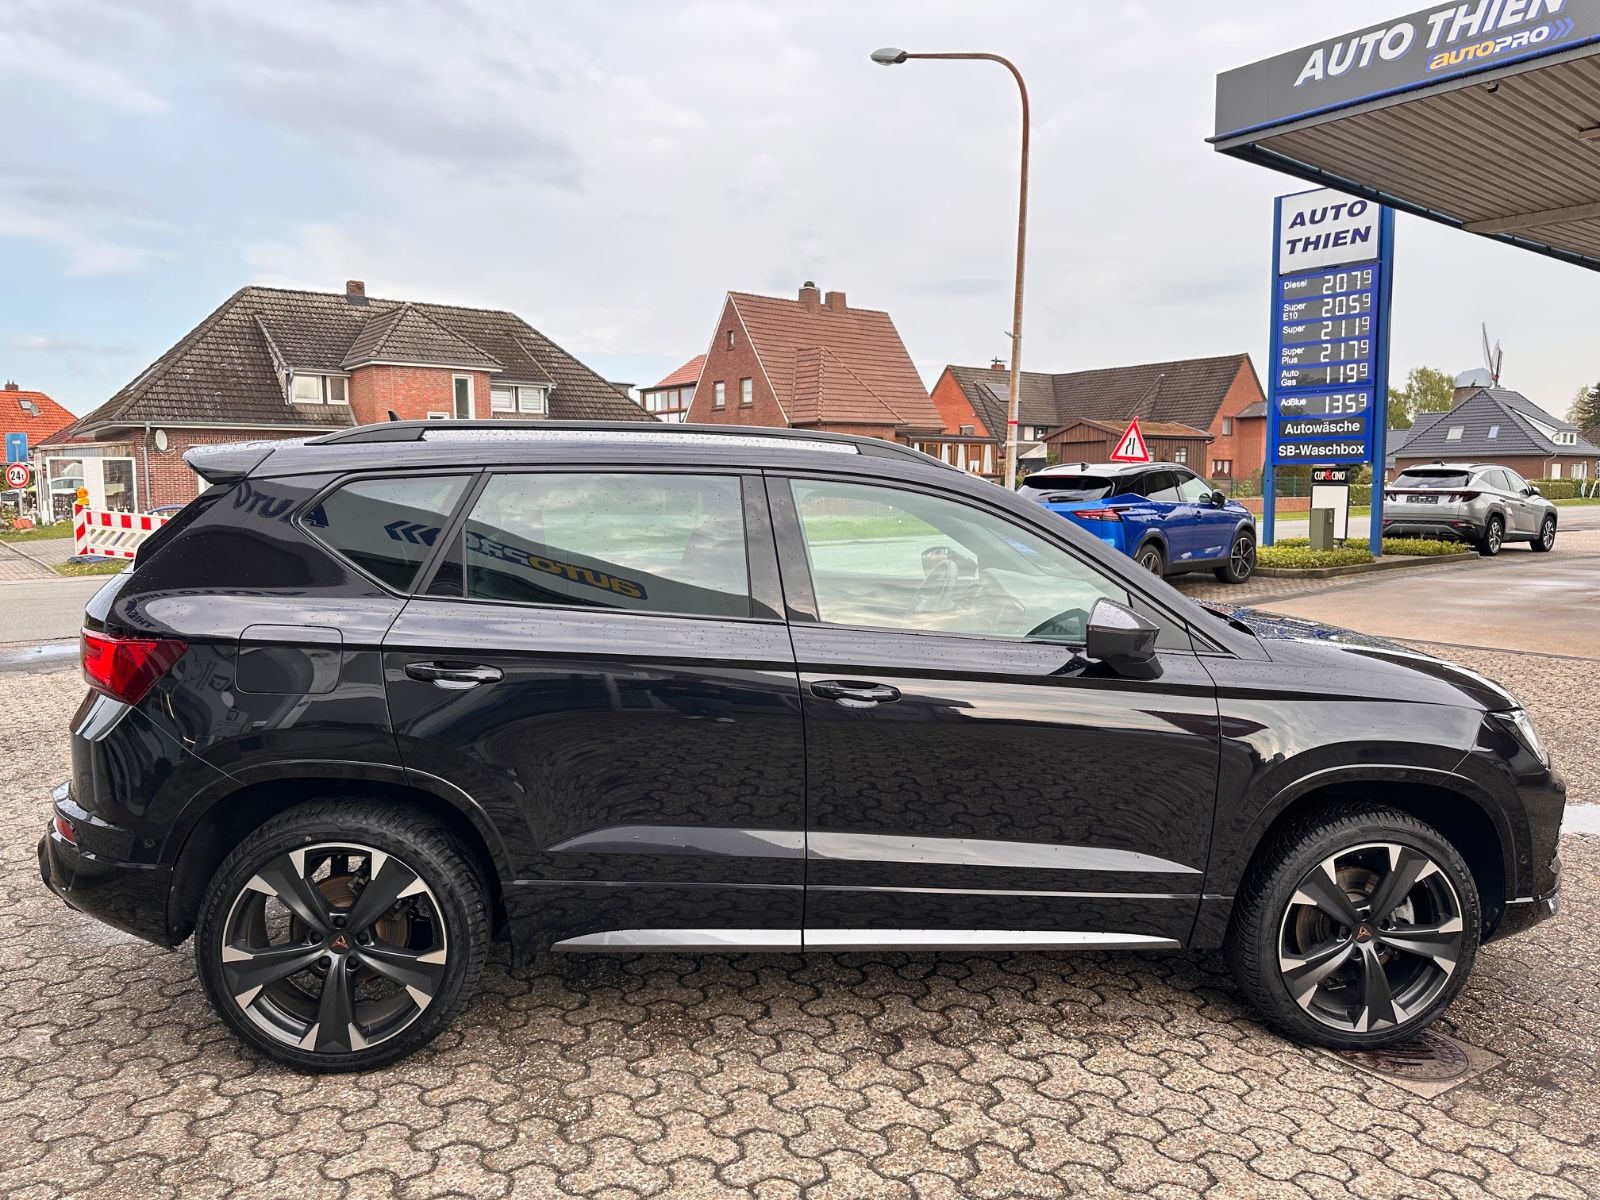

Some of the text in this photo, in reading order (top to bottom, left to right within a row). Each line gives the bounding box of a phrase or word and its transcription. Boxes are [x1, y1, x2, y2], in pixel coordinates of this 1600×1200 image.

[1294, 22, 1415, 87] AUTO
[1288, 199, 1368, 230] AUTO
[1286, 225, 1372, 255] THIEN
[1283, 279, 1308, 290] Diesel
[1282, 303, 1307, 313] Super
[1282, 312, 1299, 321] E10
[1282, 325, 1306, 335] Super
[1281, 347, 1305, 357] Super
[1281, 356, 1298, 366] Plus
[1281, 369, 1300, 378] Auto
[1280, 378, 1297, 387] Gas
[1280, 397, 1307, 407] AdBlue
[1284, 420, 1361, 435] Autowäsche
[1278, 443, 1365, 457] SB-Waschbox
